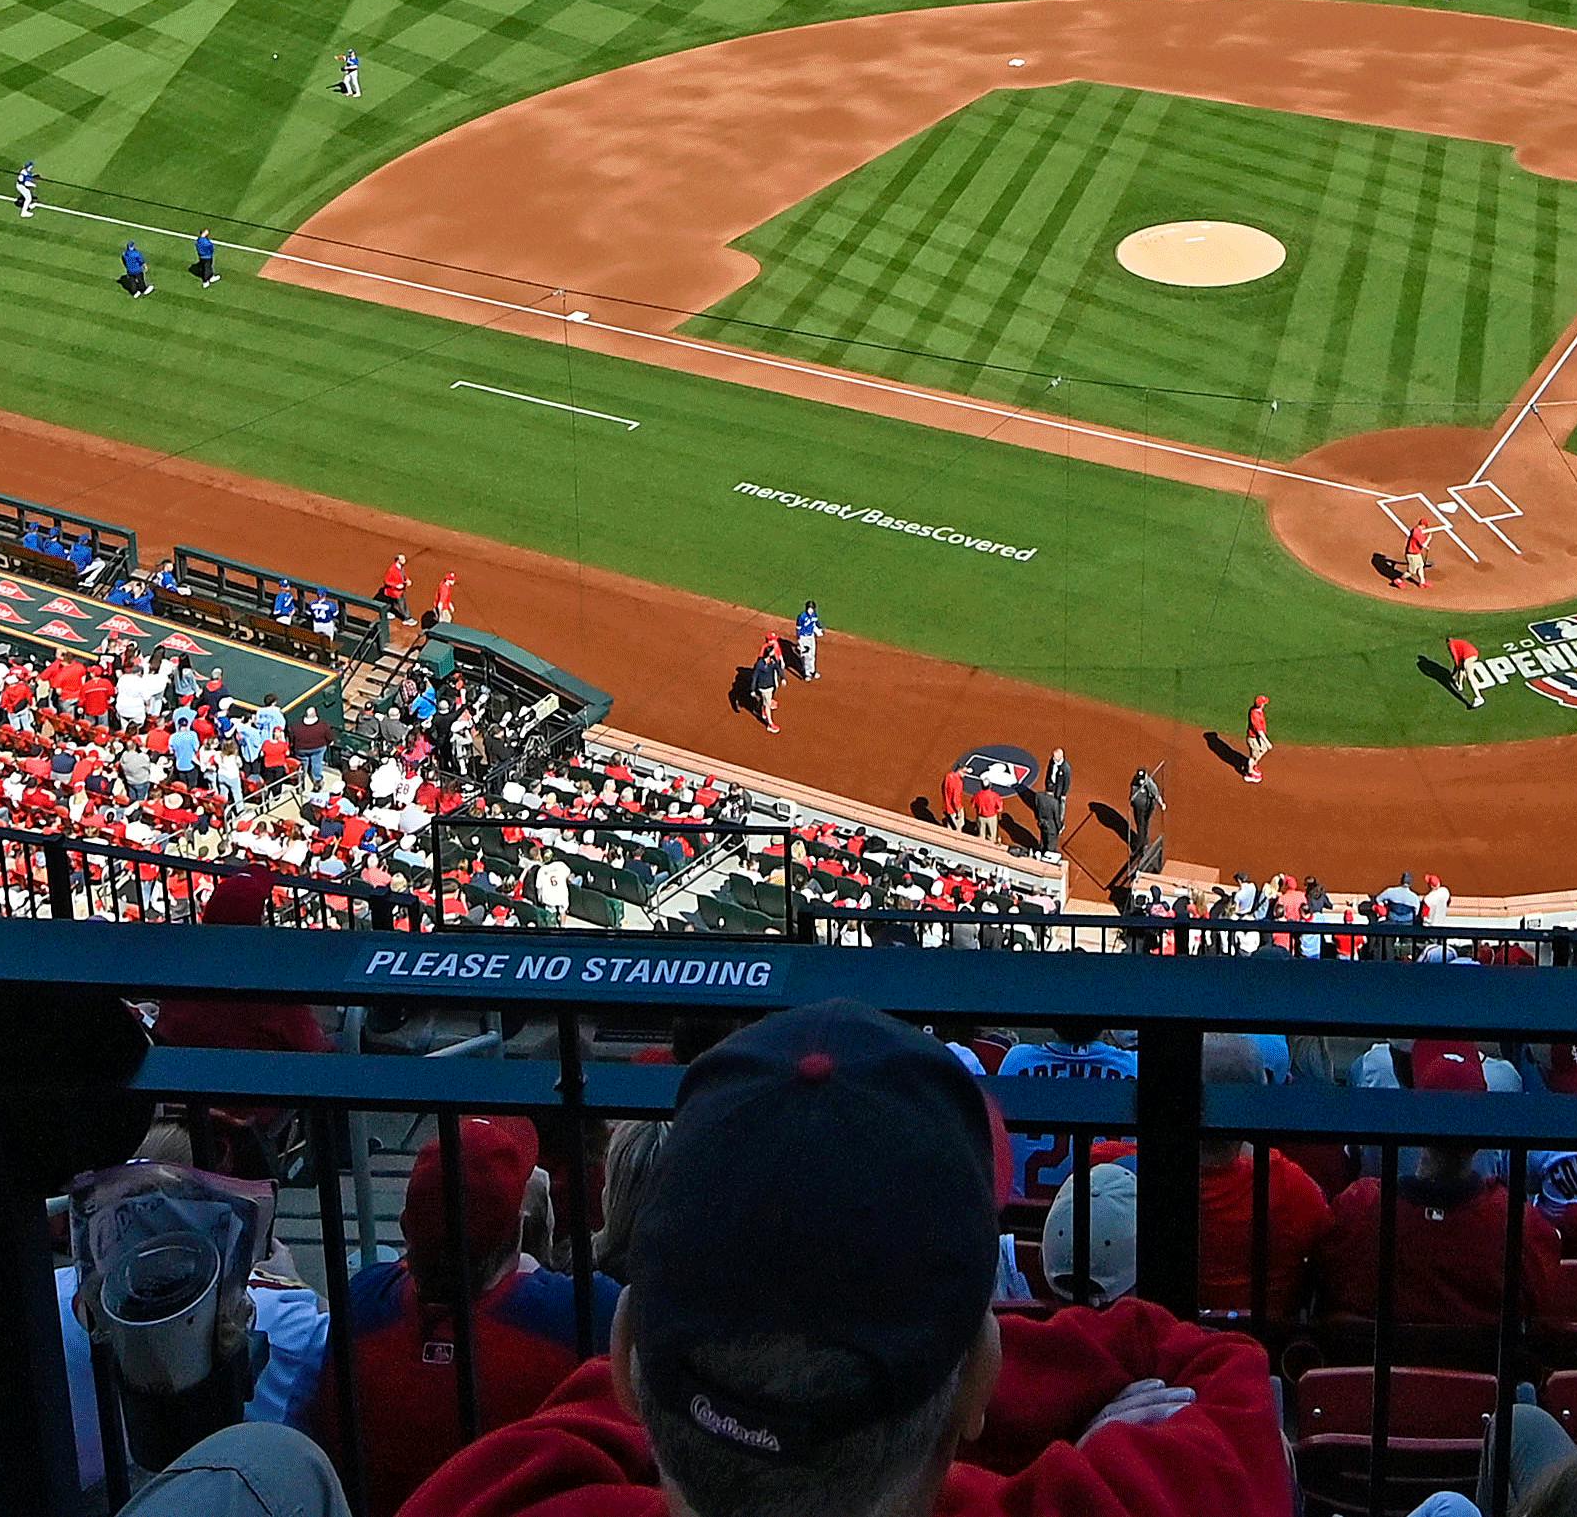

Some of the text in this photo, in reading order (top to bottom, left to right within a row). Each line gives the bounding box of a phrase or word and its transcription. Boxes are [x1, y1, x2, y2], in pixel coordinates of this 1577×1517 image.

[733, 481, 1037, 562] mercy.net/BasesCovered
[1502, 638, 1536, 652] 20
[365, 949, 773, 989] PLEASE NO STANDING
[690, 1393, 780, 1452] Cardinals
